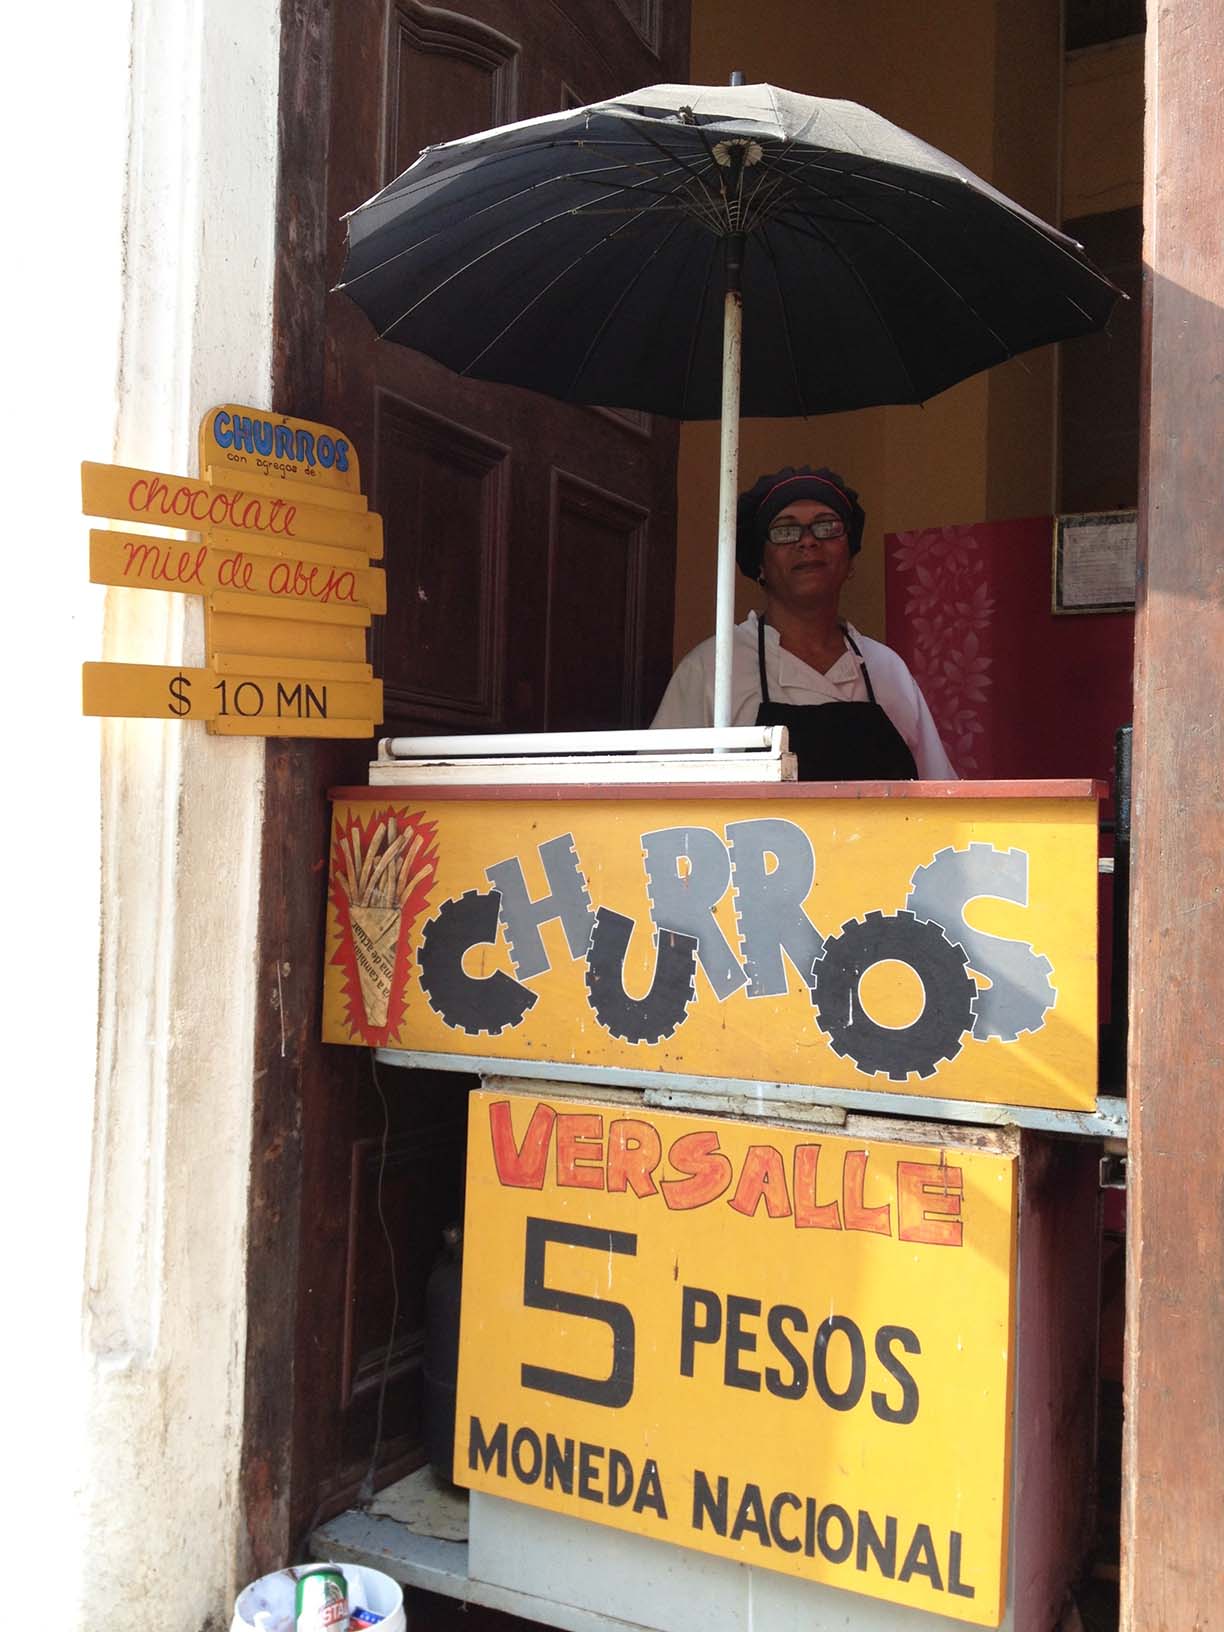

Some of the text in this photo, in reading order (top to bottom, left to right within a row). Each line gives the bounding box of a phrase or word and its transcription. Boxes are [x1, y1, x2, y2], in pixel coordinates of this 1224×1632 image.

[213, 410, 349, 473] CHURROS
[226, 452, 248, 463] con
[304, 466, 317, 477] de
[129, 477, 296, 537] chocolate
[123, 542, 359, 603] miel de abeja
[168, 672, 328, 719] $ 10 MN
[416, 818, 1057, 1082] CHURROS
[489, 1100, 964, 1247] VERSALLE
[520, 1216, 922, 1425] 5 PESOS
[468, 1416, 976, 1599] MONEDA NACIONAL
